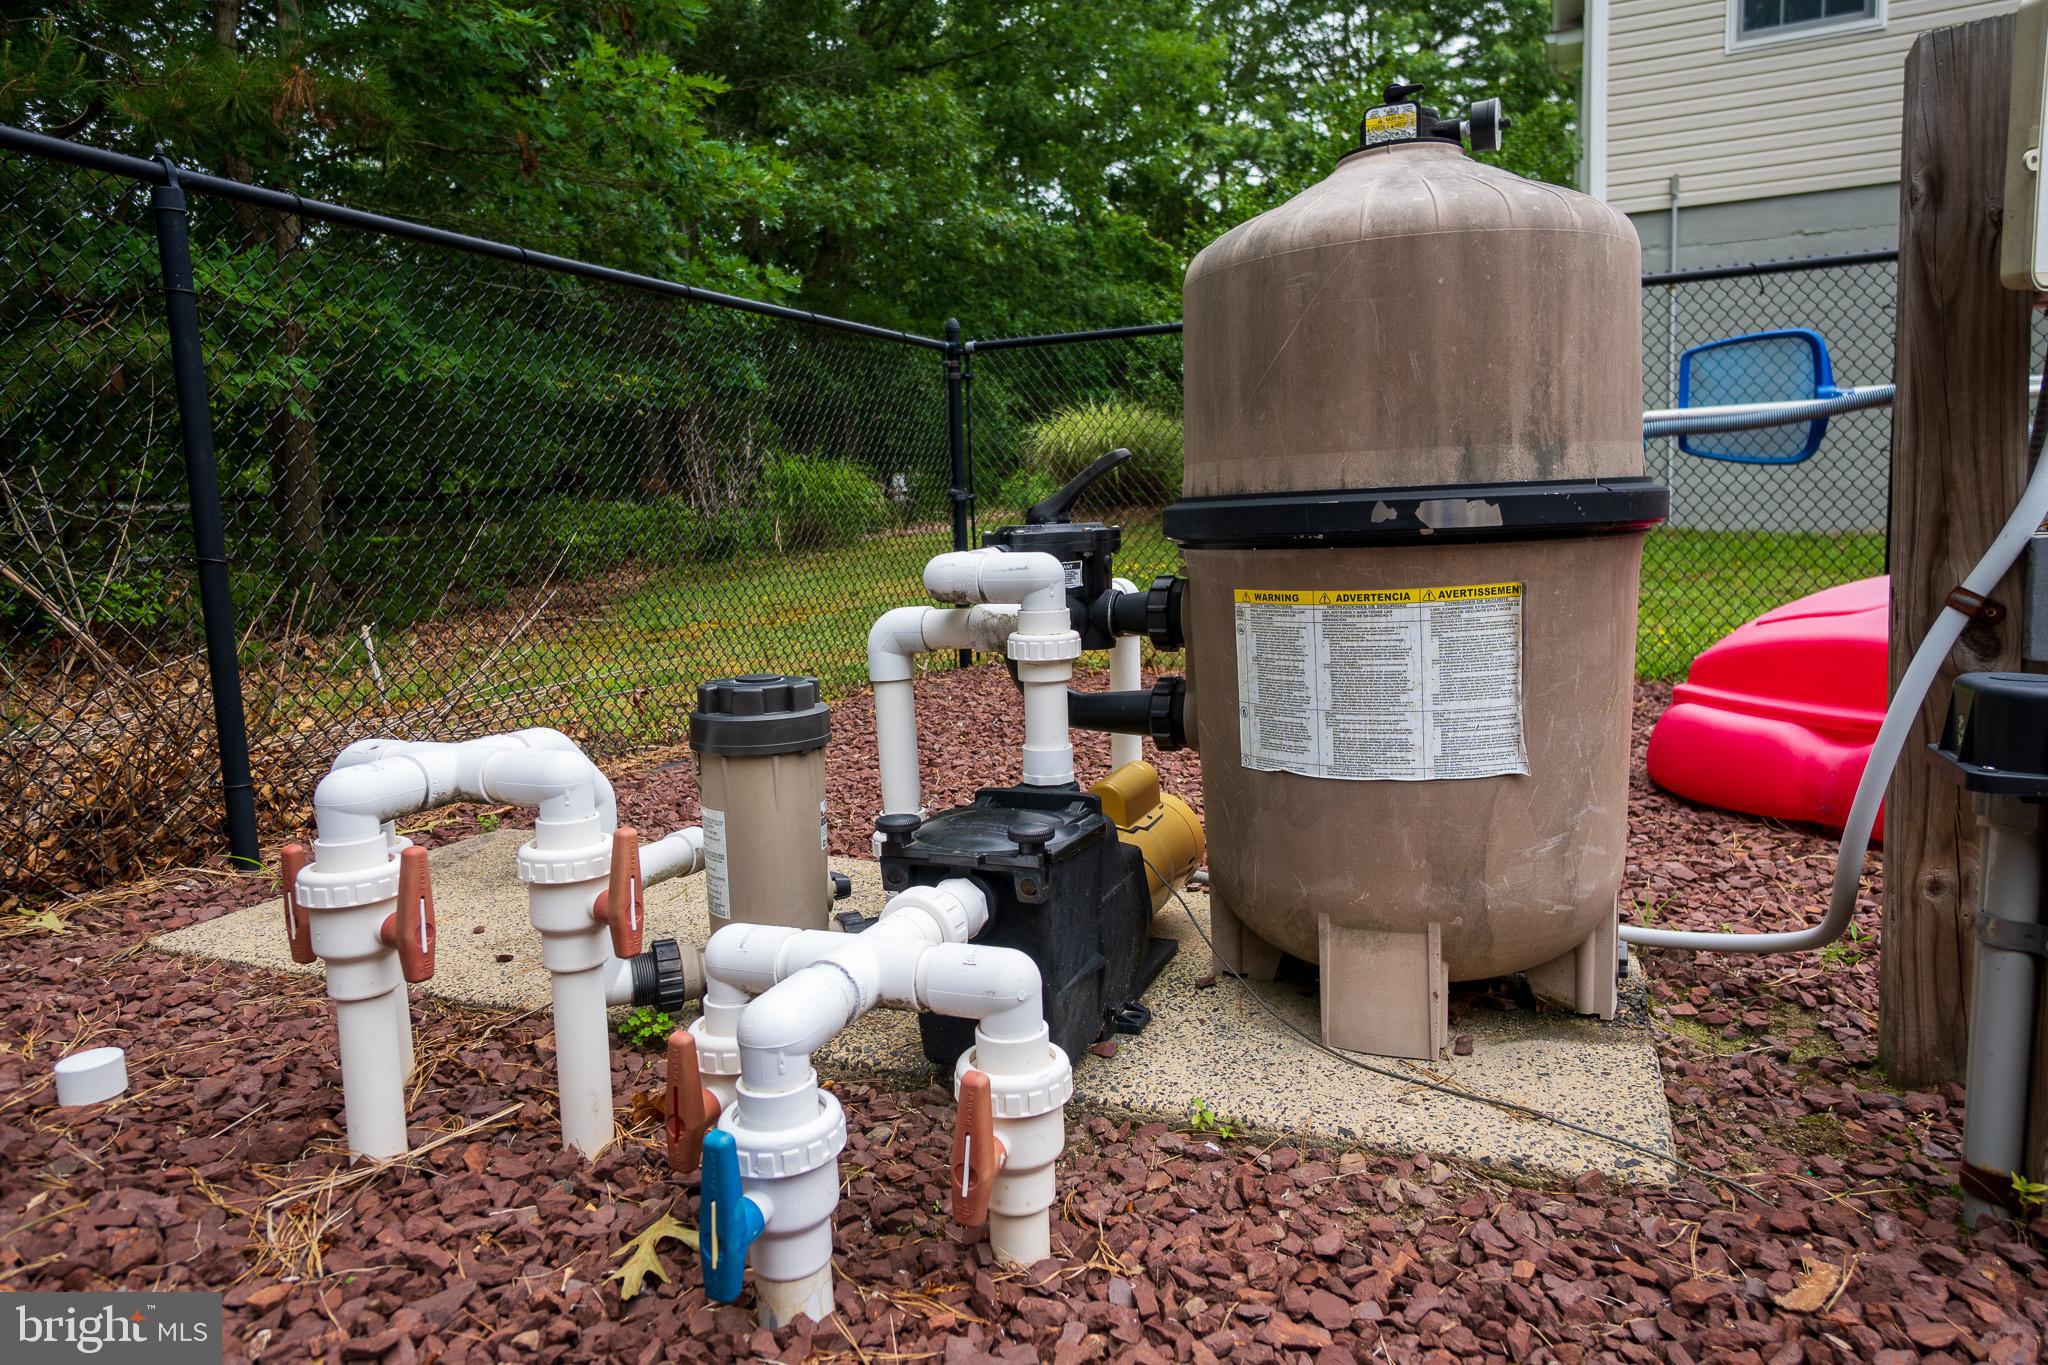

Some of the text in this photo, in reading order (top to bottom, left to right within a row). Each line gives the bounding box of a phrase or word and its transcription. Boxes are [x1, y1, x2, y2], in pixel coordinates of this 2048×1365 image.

[1336, 592, 1411, 602] ADVERTENCIA
[1438, 585, 1521, 599] AVERTISSEMEN
[1254, 593, 1300, 602] WARNING
